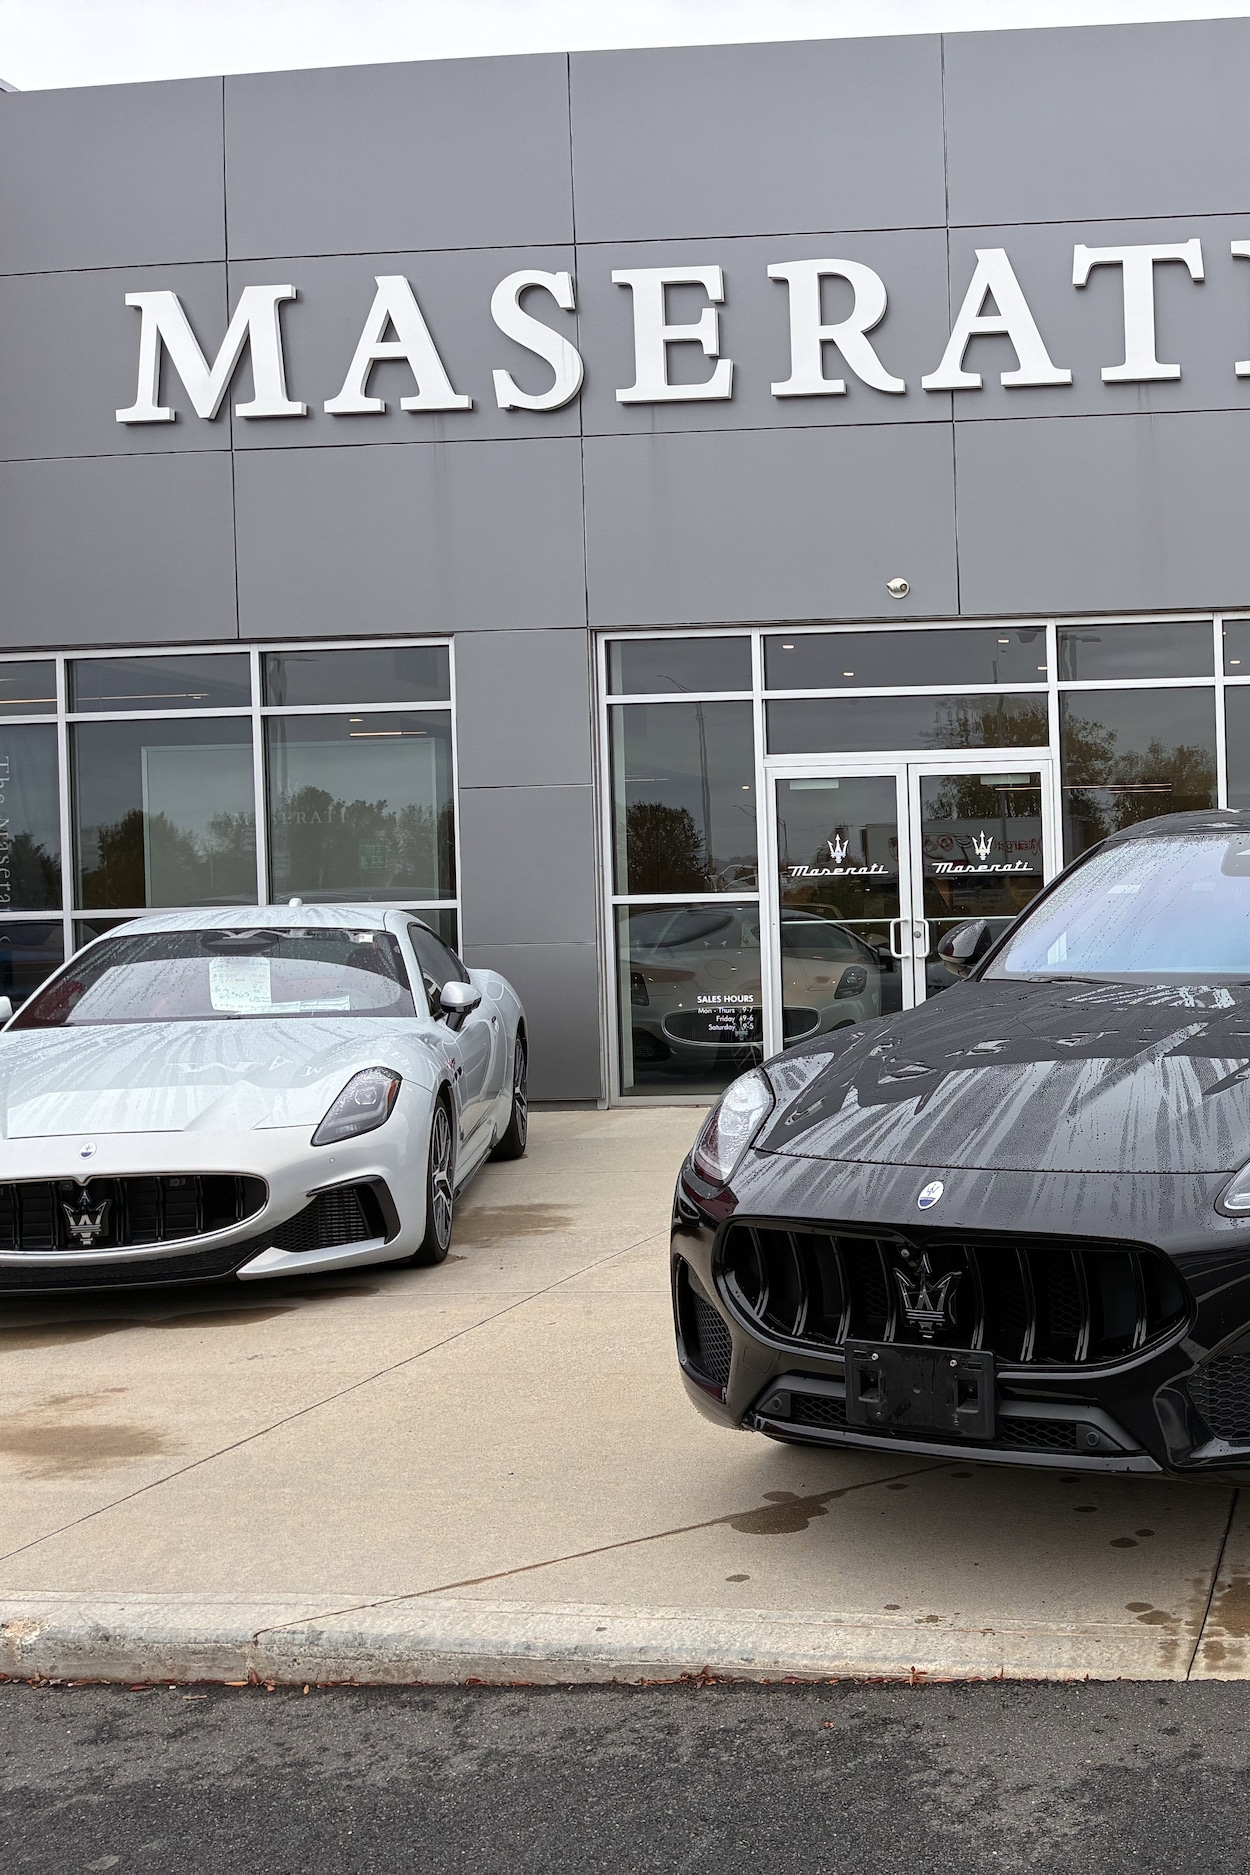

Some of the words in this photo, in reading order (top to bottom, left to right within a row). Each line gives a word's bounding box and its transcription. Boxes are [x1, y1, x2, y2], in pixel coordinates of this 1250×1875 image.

[787, 863, 890, 877] Maserati
[931, 860, 1034, 873] Maserati
[697, 995, 722, 1003] SALES
[724, 994, 754, 1003] HOURS
[708, 1023, 736, 1031] Saturday
